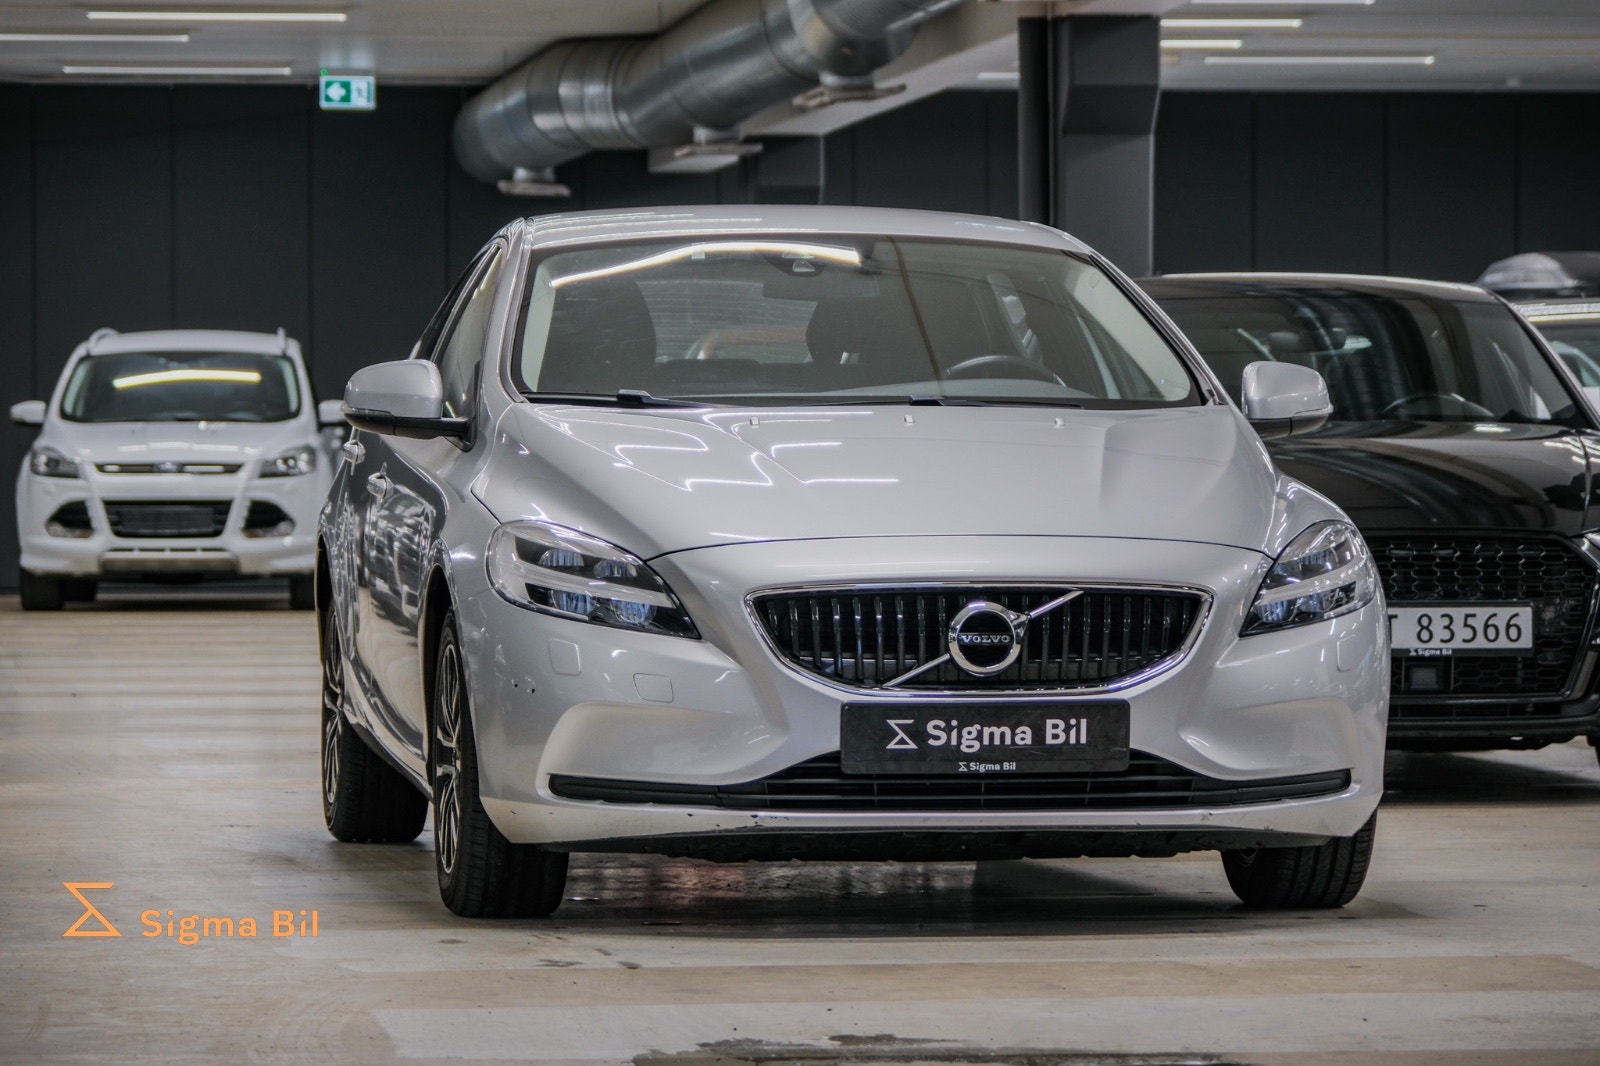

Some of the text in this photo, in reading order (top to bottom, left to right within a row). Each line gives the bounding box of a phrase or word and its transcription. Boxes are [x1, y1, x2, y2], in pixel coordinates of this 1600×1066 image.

[1416, 612, 1522, 644] 83566
[960, 634, 1011, 644] VOLVO
[1417, 648, 1441, 657] Sigma
[926, 718, 1088, 753] Sigma Bil
[969, 761, 1016, 773] Sigma Bil
